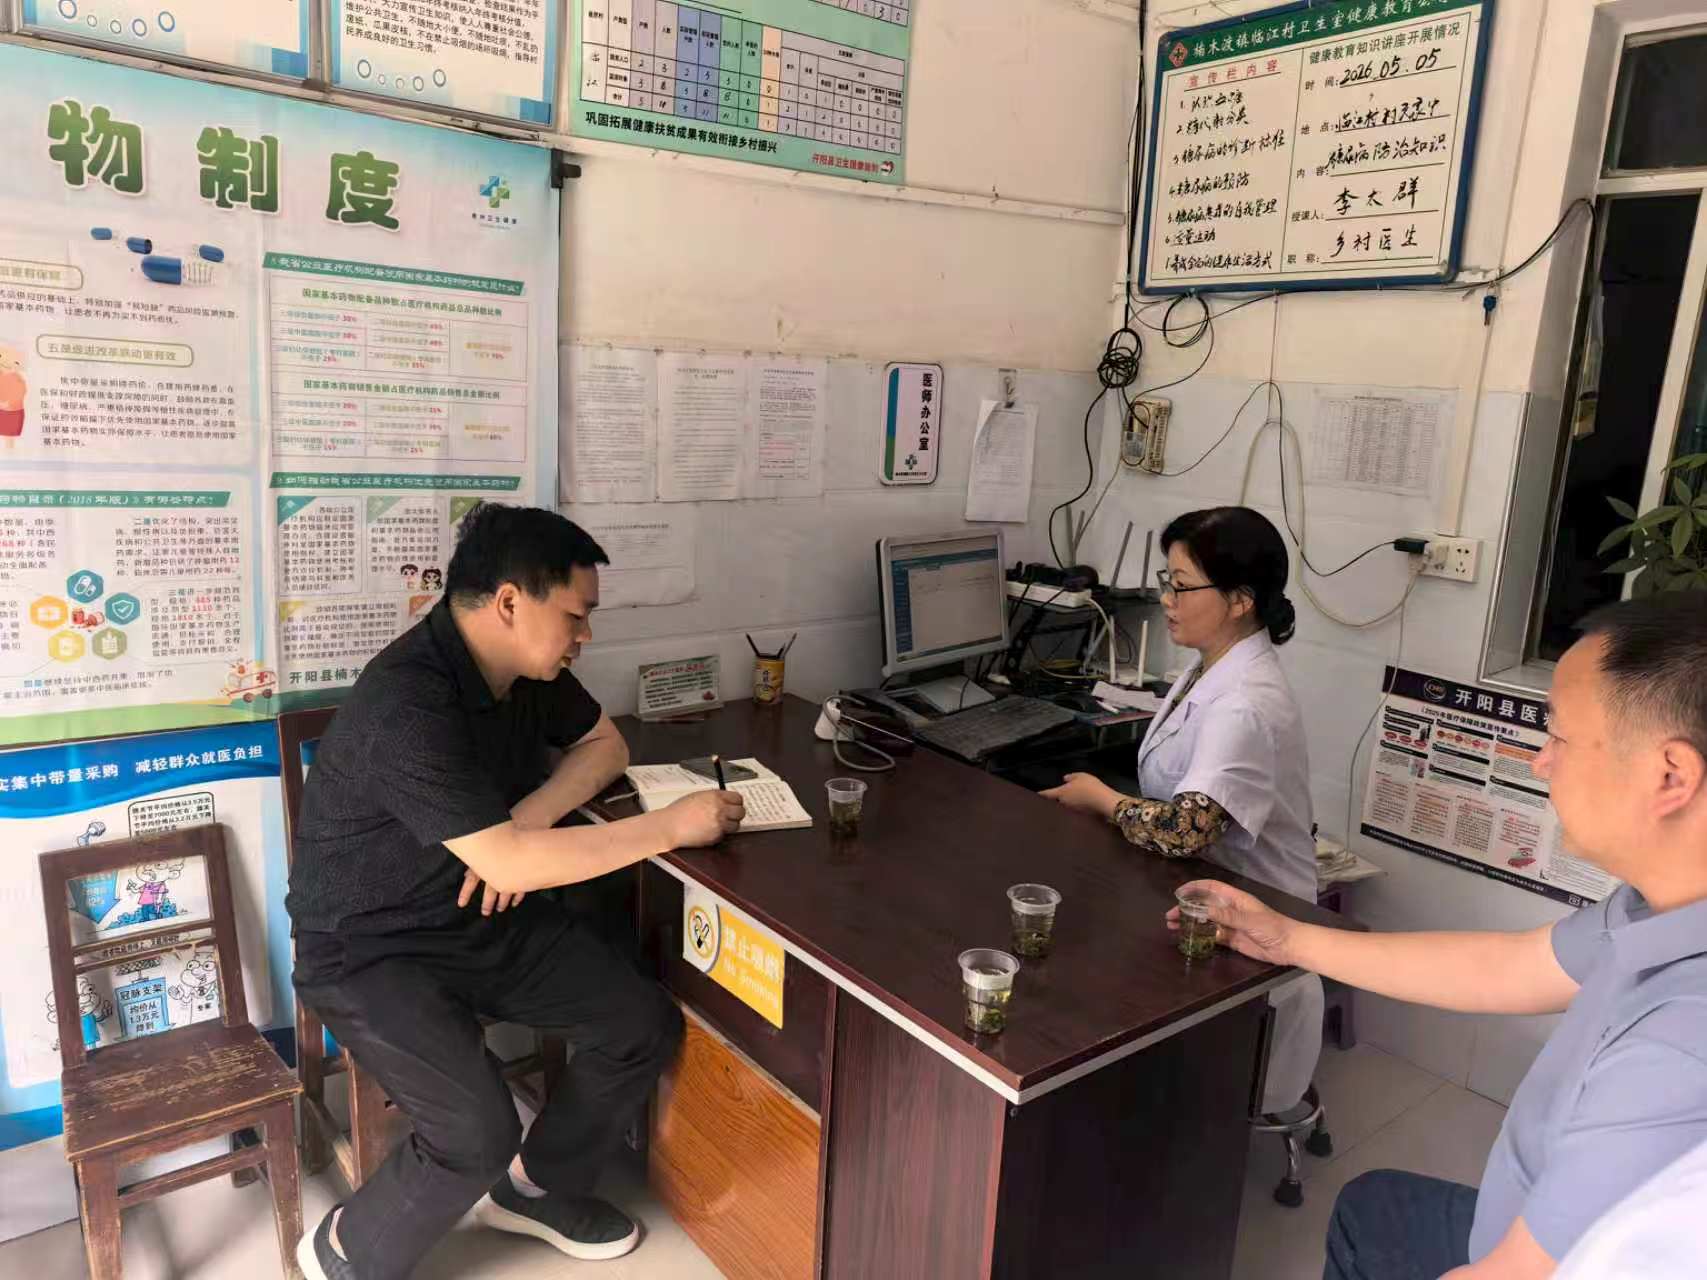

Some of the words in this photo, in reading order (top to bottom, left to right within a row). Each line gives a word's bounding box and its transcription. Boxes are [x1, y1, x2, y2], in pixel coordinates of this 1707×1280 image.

[1193, 0, 1447, 57] 楠木渡镇临江村卫生室健康教育
[1309, 21, 1460, 64] 健康教育知识讲座开展情况
[1188, 60, 1279, 88] 宣传栏内容
[585, 111, 778, 153] 巩固拓展健康扶贫成果有效衔接乡村振兴
[1330, 224, 1418, 258] 乡村医生
[918, 373, 933, 451] 医师办公室
[136, 745, 264, 774] 减轻群众就医负担
[120, 984, 162, 1000] 冠脉支架
